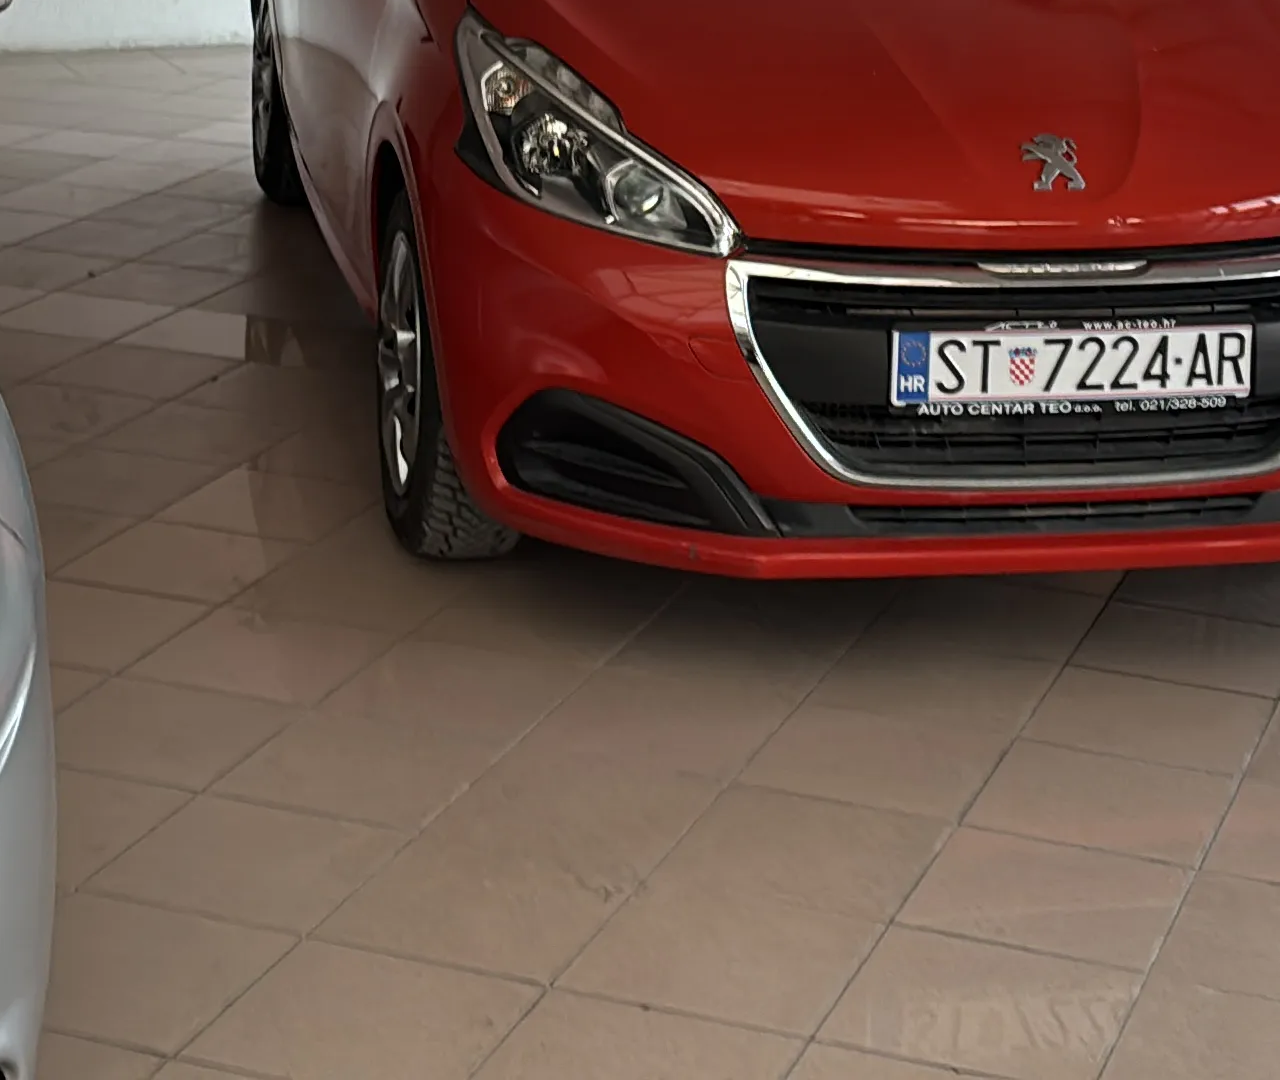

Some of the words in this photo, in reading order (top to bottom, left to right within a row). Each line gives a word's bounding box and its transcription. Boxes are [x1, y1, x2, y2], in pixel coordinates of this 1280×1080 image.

[935, 339, 1002, 395] ST
[899, 374, 926, 393] HR
[917, 402, 964, 416] AUTO
[967, 402, 1035, 416] CENTAR
[1040, 402, 1072, 415] TEO
